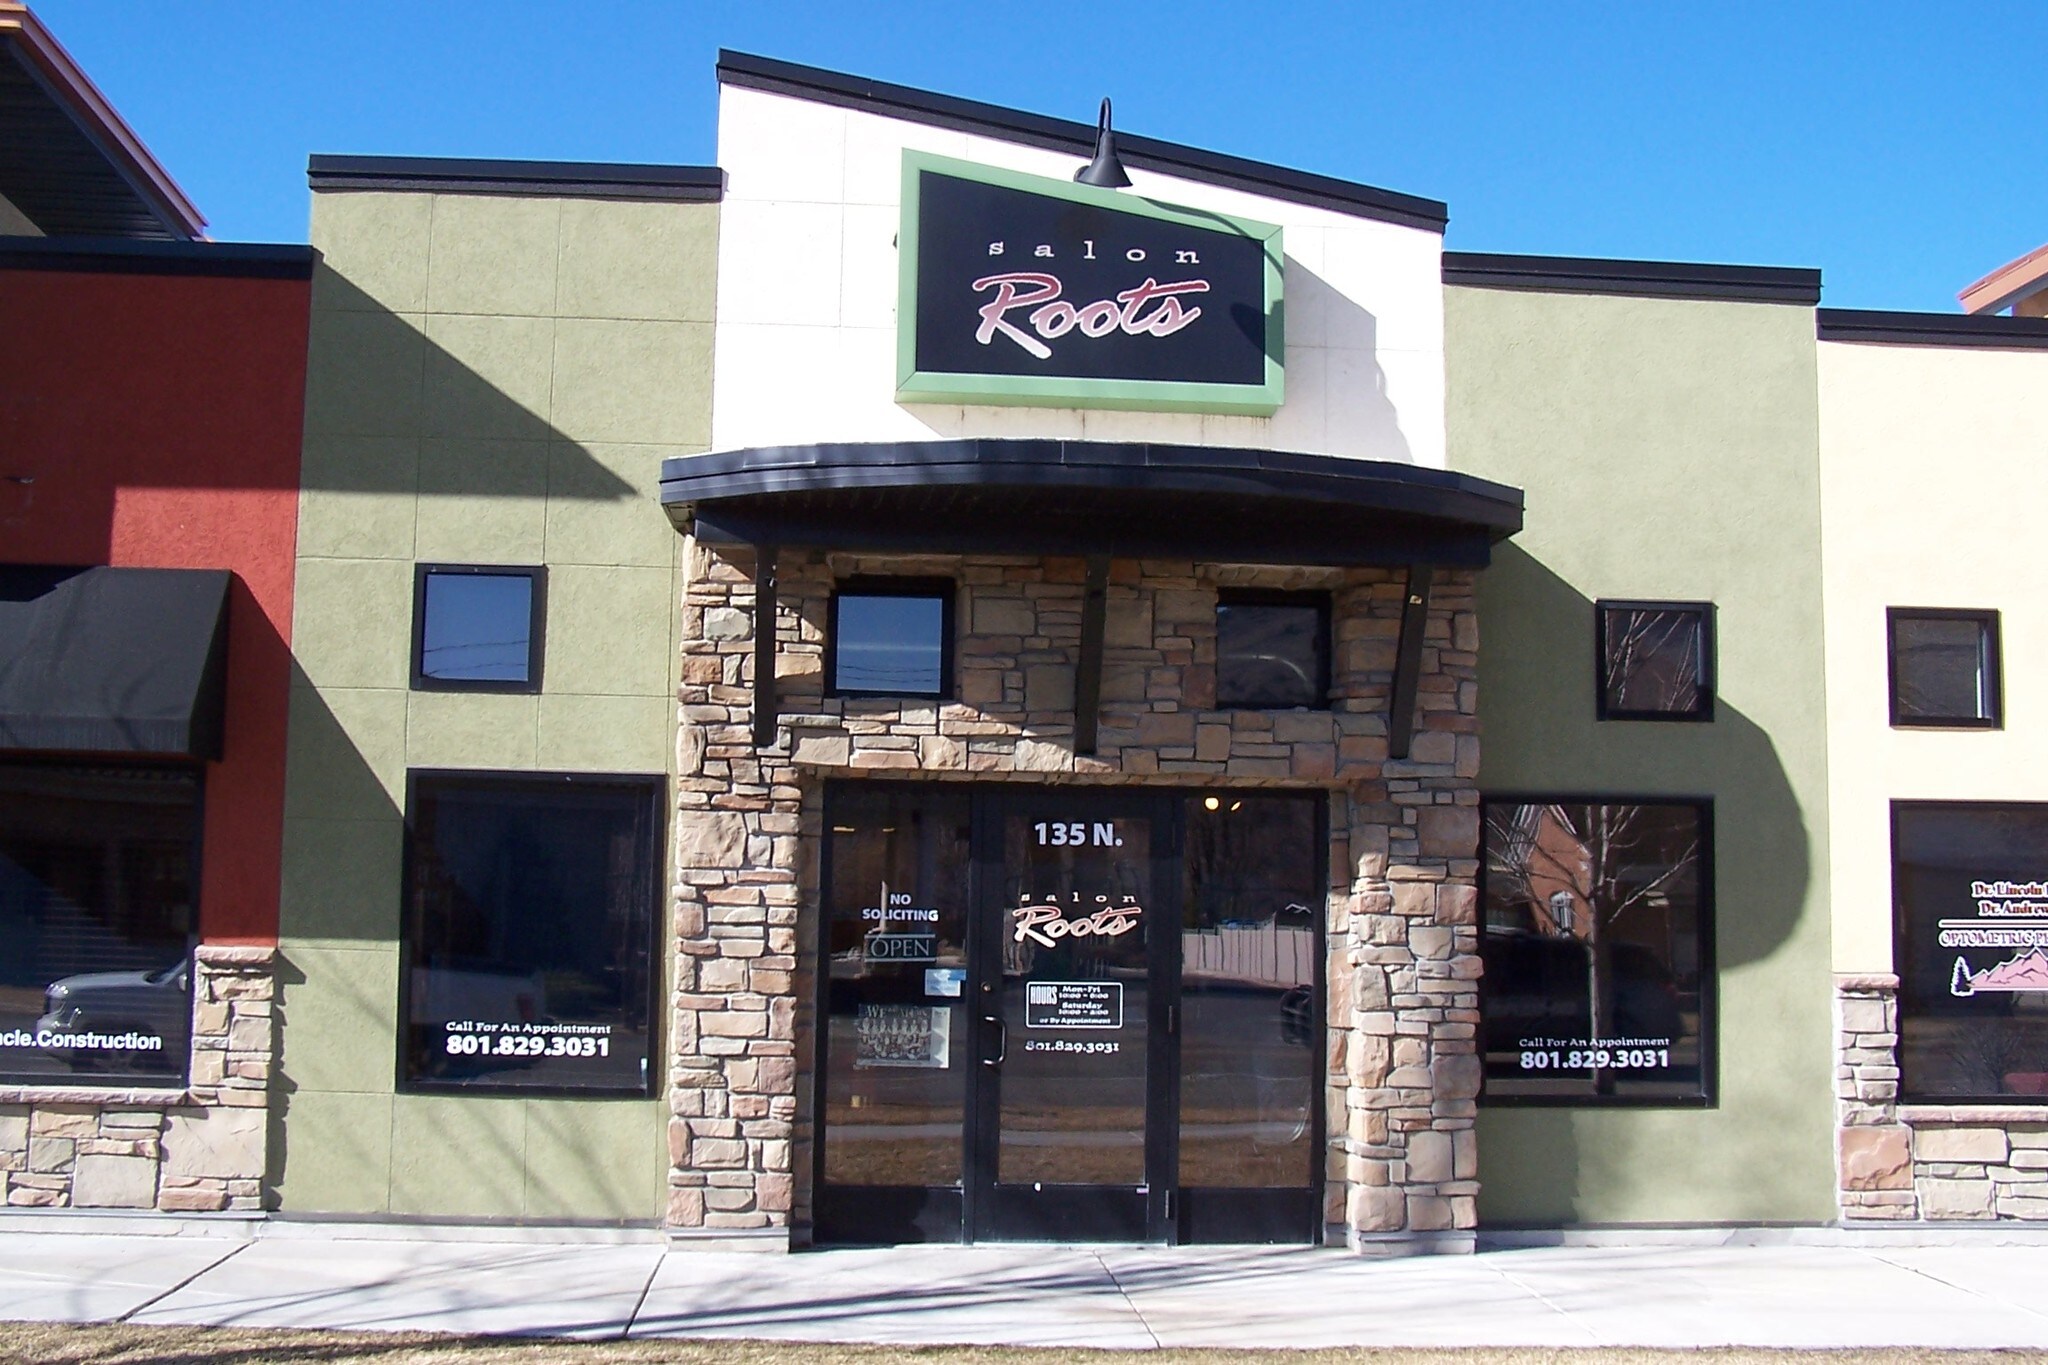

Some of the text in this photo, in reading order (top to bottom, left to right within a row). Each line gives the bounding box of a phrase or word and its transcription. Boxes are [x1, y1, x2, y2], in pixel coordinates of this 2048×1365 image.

[988, 241, 1200, 263] salon
[973, 272, 1210, 359] Roots
[1035, 822, 1123, 846] 135 N.
[1972, 882, 1994, 897] Dr.
[1997, 882, 2043, 897] Lincoln
[890, 894, 912, 905] NO
[1021, 892, 1136, 903] salon
[862, 908, 939, 921] SOLICITING
[1979, 901, 2000, 915] Dr.
[1012, 905, 1142, 947] Roots
[1939, 930, 2034, 946] OPTOMETRIC
[871, 939, 930, 957] OPEN
[1030, 986, 1057, 1004] HOURS
[446, 1021, 611, 1035] Call For An Appointment
[1061, 1017, 1111, 1025] Appointment
[446, 1035, 609, 1057] 801.829.3031
[1025, 1040, 1119, 1053] 801.829.3031
[1519, 1037, 1670, 1048] Call For An Appointment
[1520, 1050, 1669, 1069] 801.829.3031
